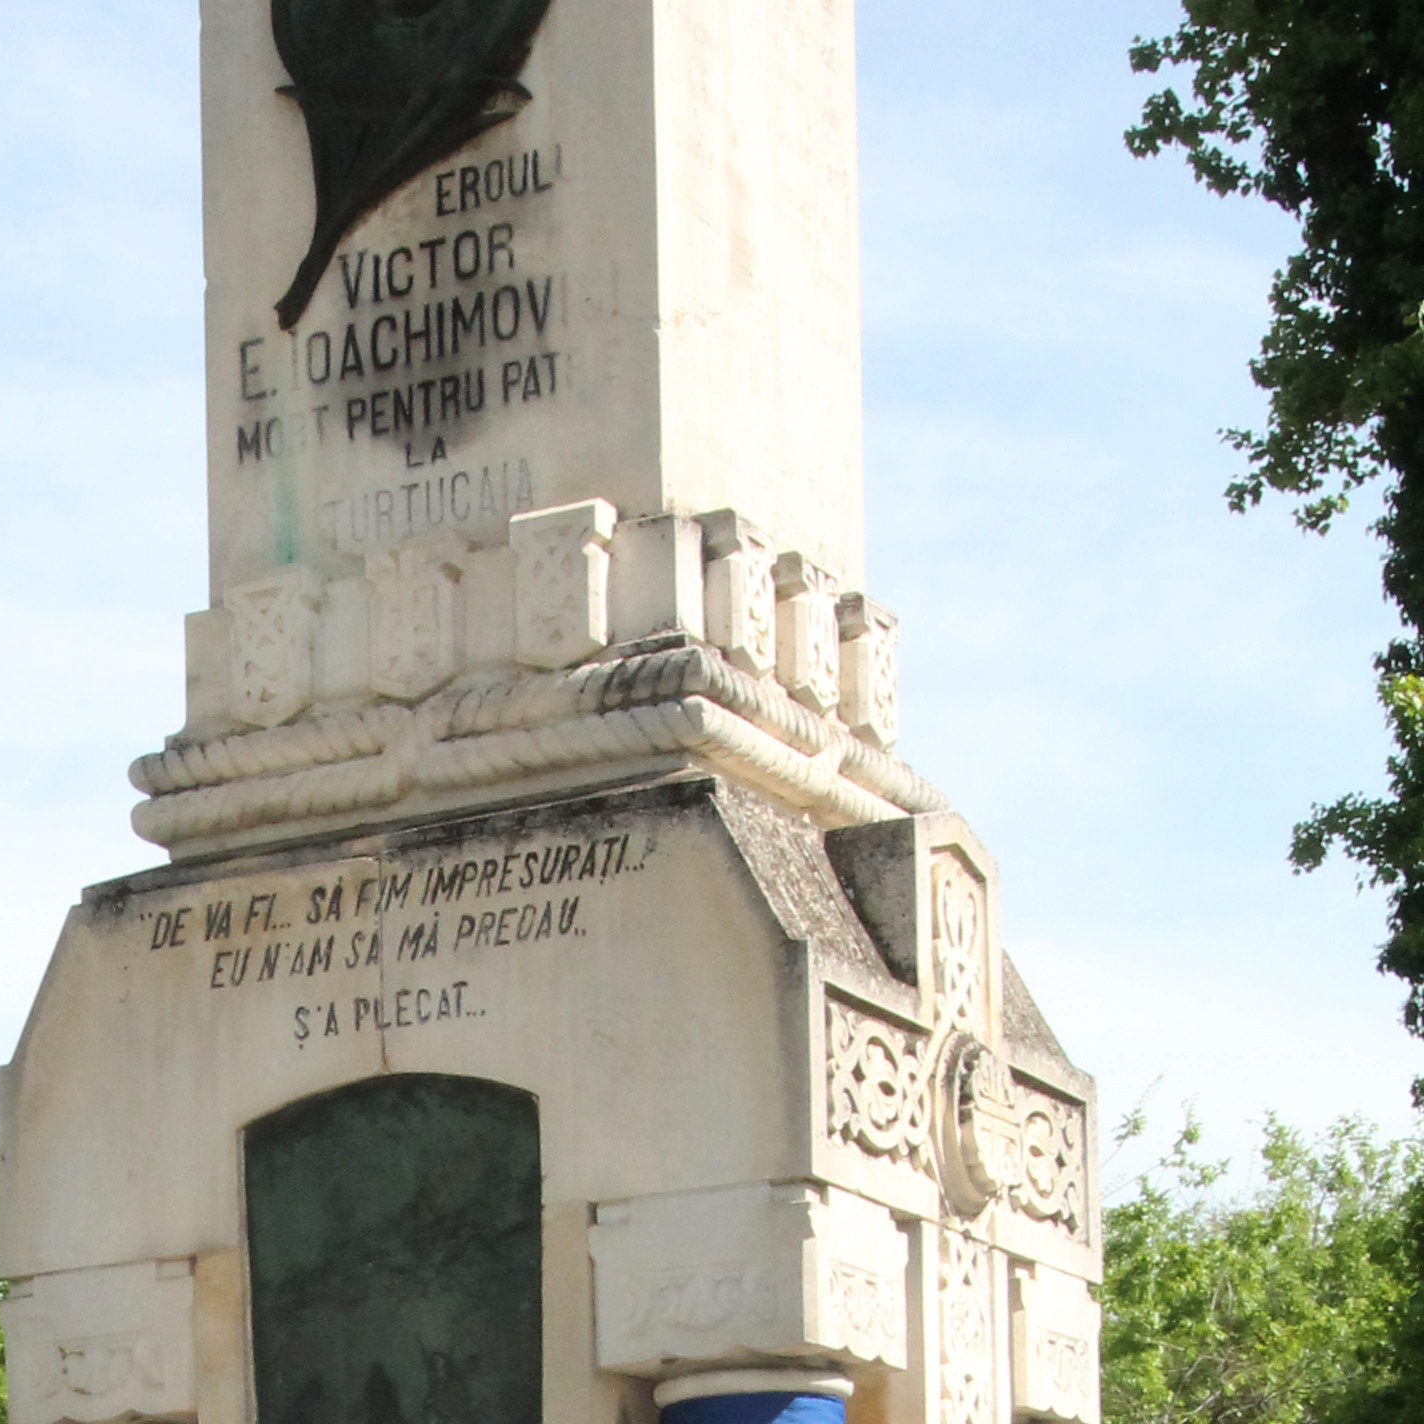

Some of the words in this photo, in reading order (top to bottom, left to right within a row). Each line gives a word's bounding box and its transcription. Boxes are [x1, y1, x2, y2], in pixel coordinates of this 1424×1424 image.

[338, 222, 515, 309] VICTOR
[346, 367, 485, 441] PENTRU
[405, 436, 448, 469] LA
[205, 901, 233, 942] VA
[211, 947, 251, 989] EU
